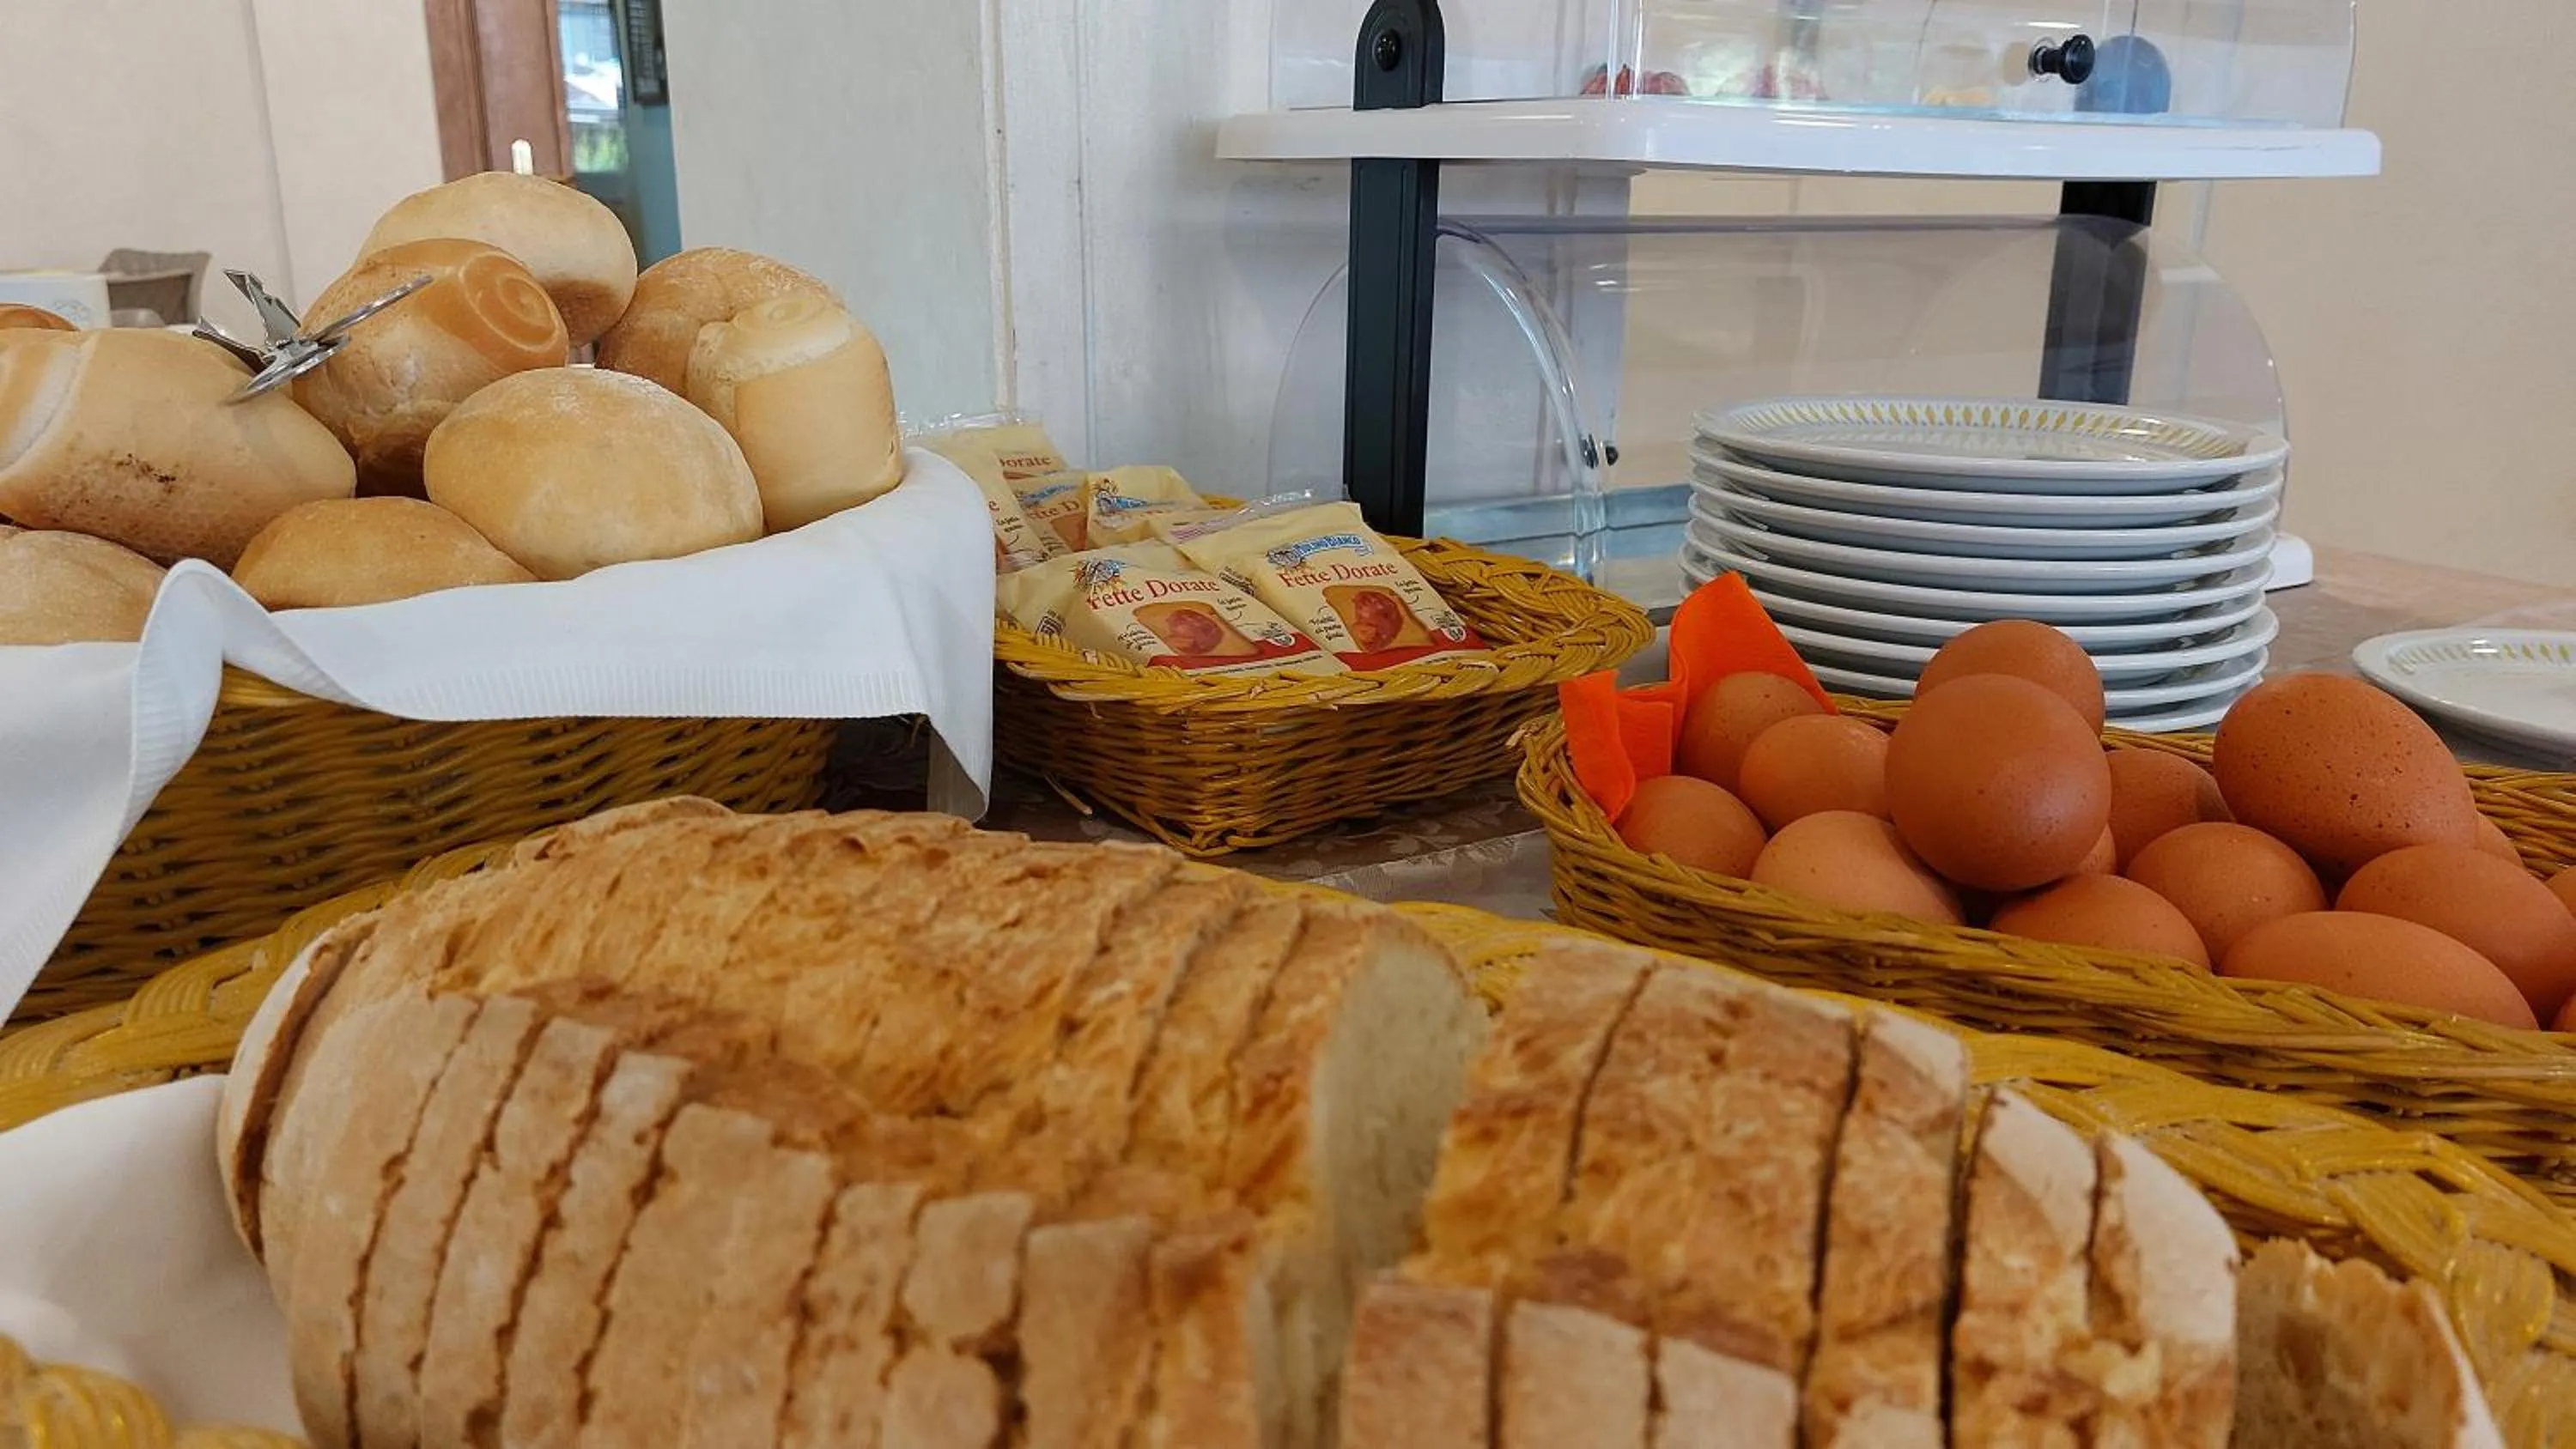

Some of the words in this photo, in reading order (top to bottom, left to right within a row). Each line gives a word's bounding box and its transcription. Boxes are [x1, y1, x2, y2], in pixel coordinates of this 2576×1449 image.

[1278, 570, 1331, 588] Fette
[1330, 562, 1399, 580] Dorate
[1086, 587, 1145, 610] Fette
[1145, 579, 1220, 599] Dorate
